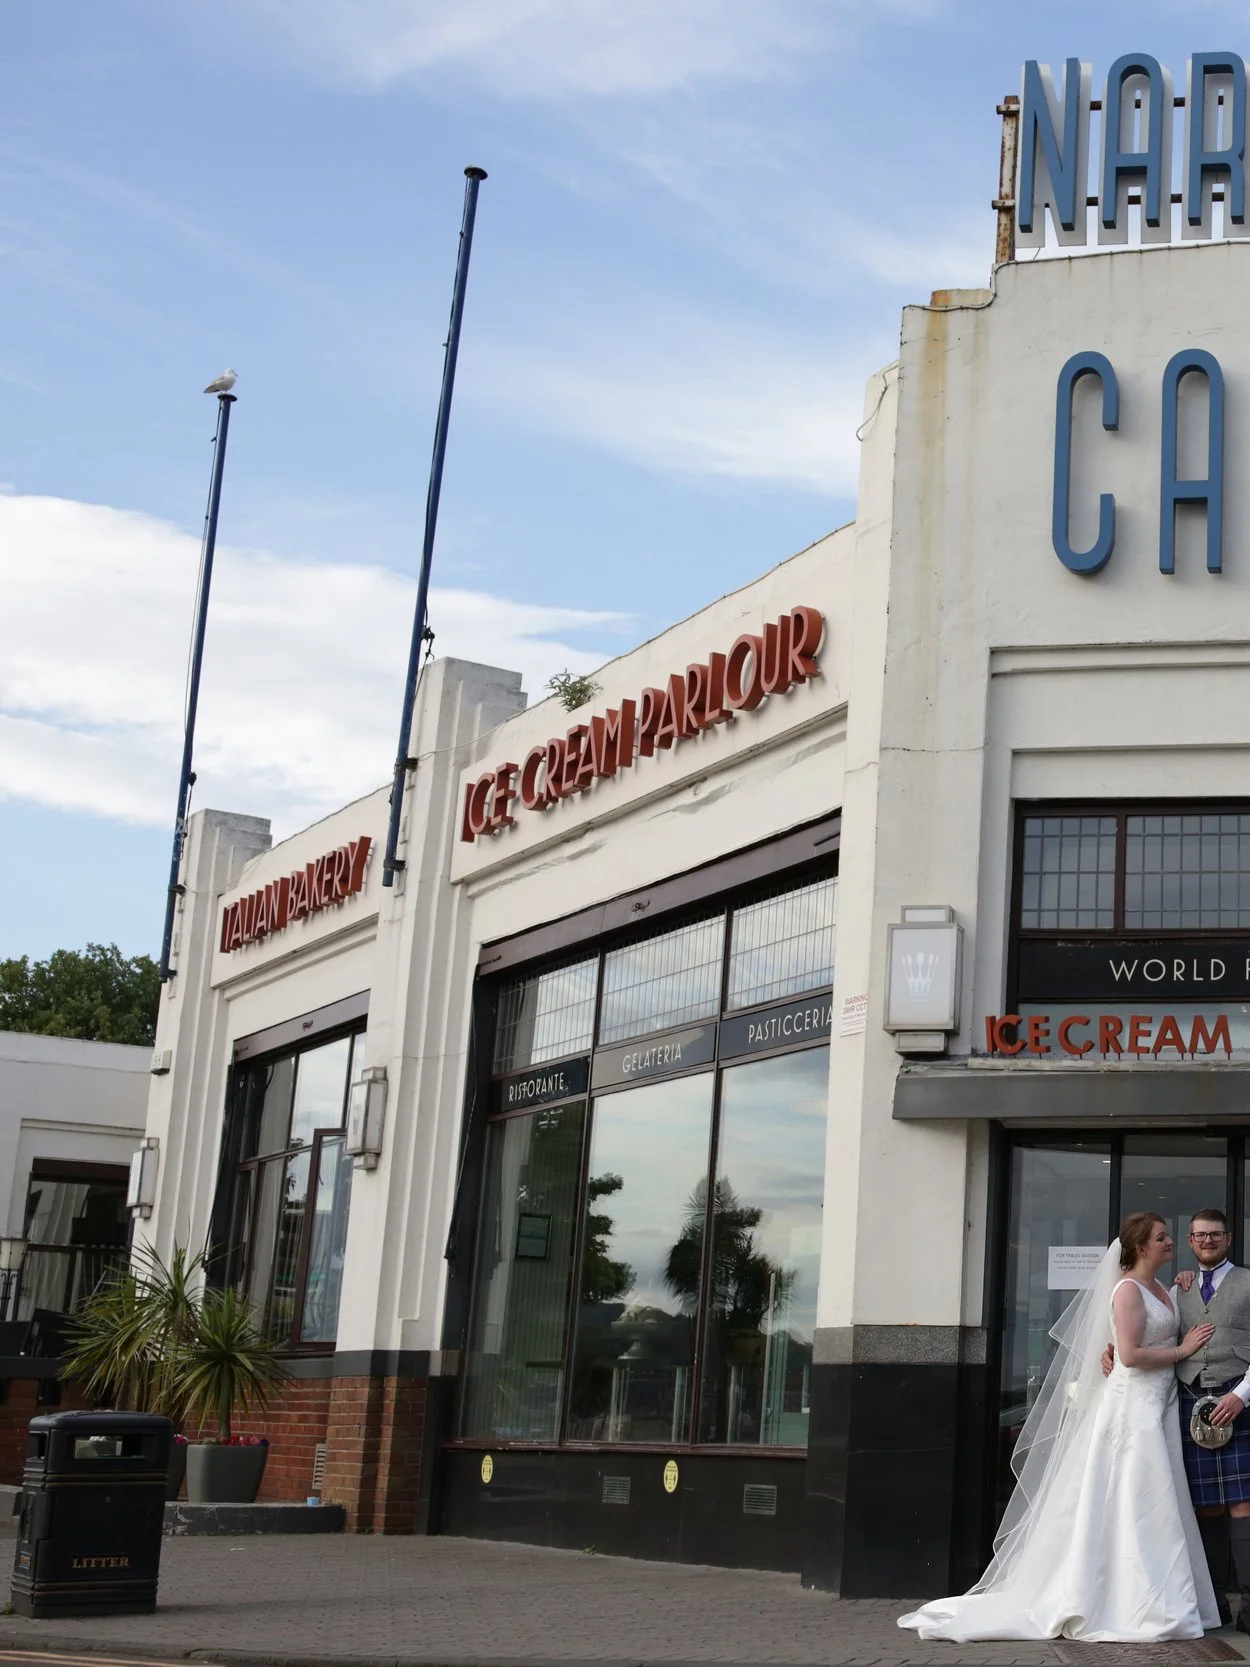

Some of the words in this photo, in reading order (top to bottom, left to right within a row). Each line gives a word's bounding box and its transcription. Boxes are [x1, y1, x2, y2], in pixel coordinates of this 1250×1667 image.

[460, 762, 519, 843] ICE
[520, 698, 636, 812] CREAM
[638, 605, 823, 757] PARLOUR
[220, 877, 291, 954] ITALIAN
[287, 836, 372, 921] BAKERY
[1109, 958, 1227, 982] WORLD
[747, 1005, 833, 1044] PASTICCERIA
[622, 1041, 682, 1074] GELATERIA
[508, 1072, 565, 1102] RISTORANTE
[72, 1557, 129, 1569] LITTER
